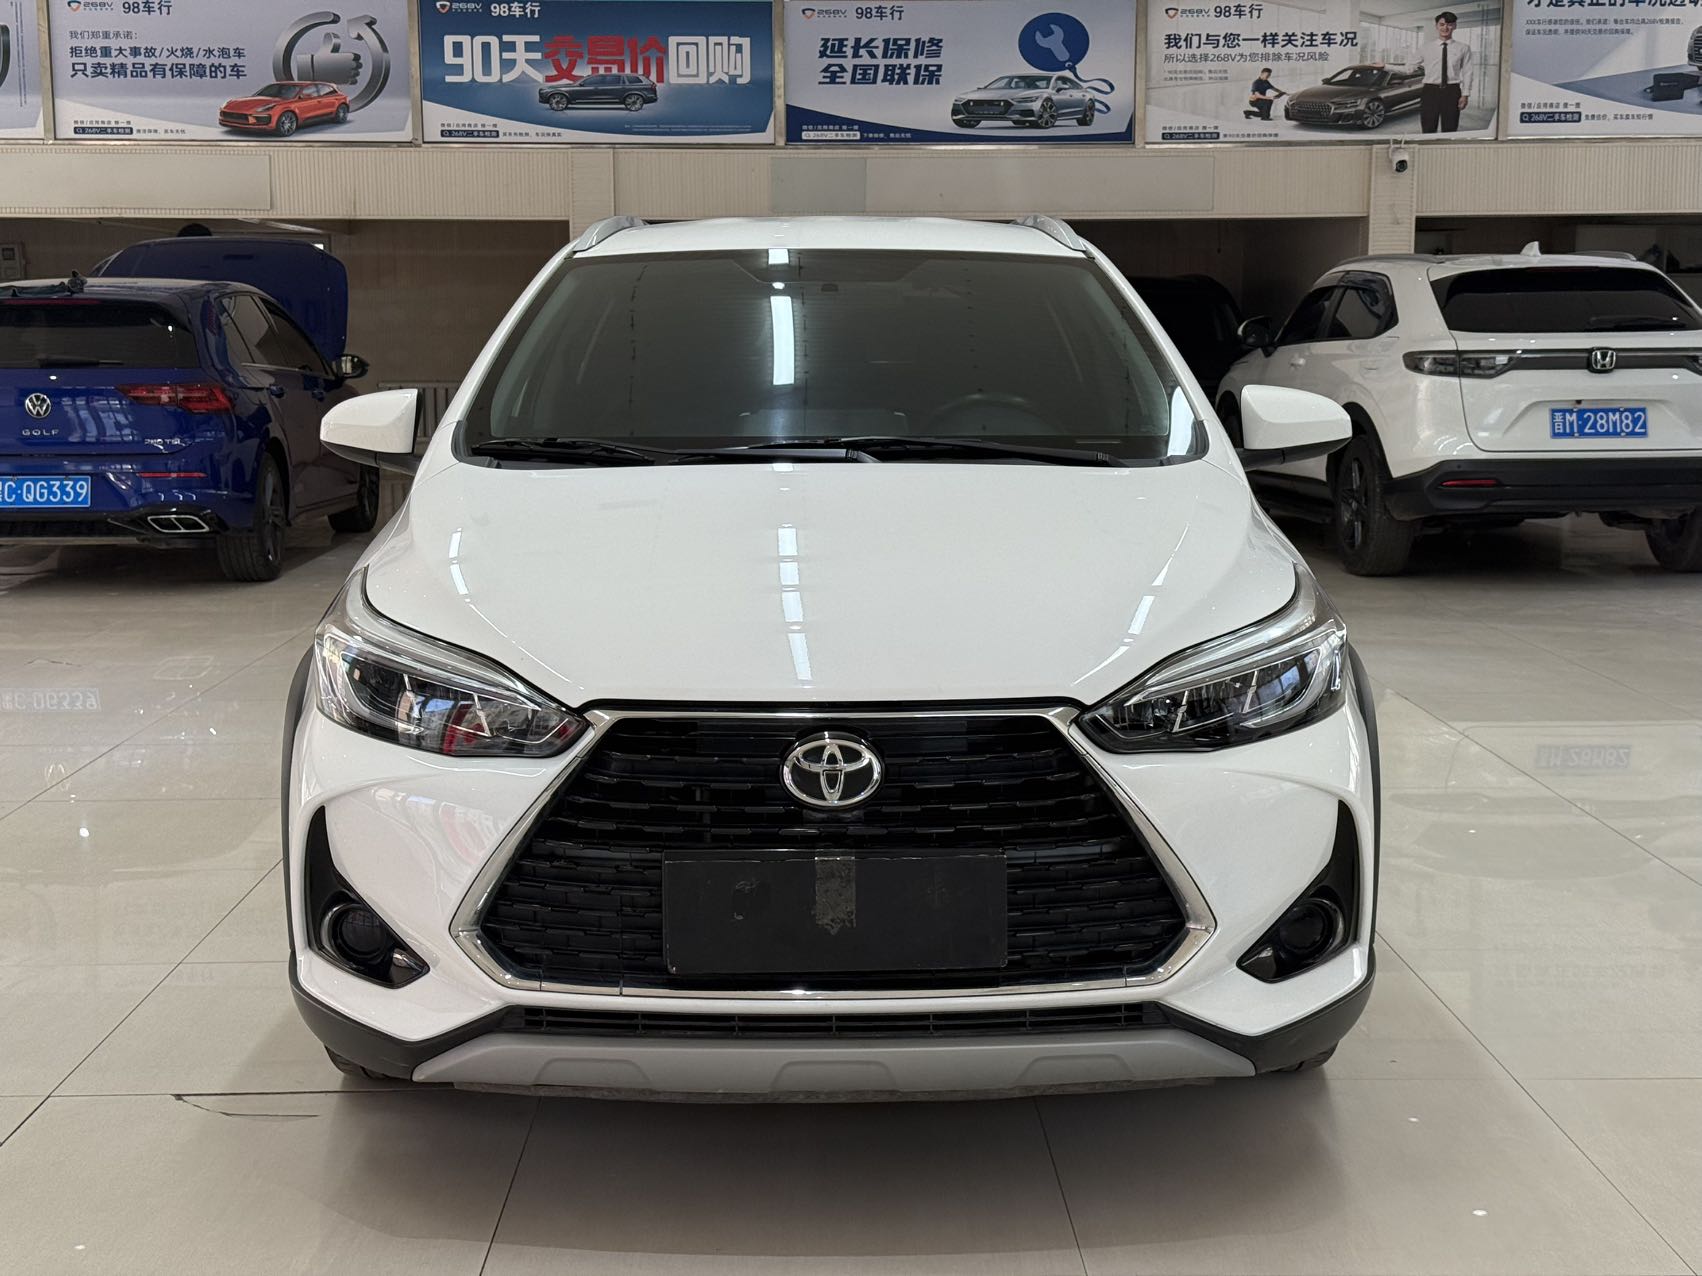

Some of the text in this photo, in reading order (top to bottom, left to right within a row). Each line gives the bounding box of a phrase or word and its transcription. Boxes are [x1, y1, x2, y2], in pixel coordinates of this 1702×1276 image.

[122, 1, 172, 15] 98车行
[490, 2, 541, 18] 98车行
[855, 5, 904, 20] 98车行
[1214, 4, 1263, 19] 98车行
[818, 37, 943, 59] 延长保修
[1164, 31, 1358, 49] 我们与您一样关注车况
[69, 46, 246, 59] 拒绝重大事故/火烧/水泡车
[443, 35, 751, 84] 90天交易价回购
[1163, 51, 1329, 64] 所以选择268V为您排除车况风险
[70, 62, 247, 79] 只卖精品有保障的车
[818, 63, 943, 85] 全国联保
[0, 481, 87, 502] C·QG339
